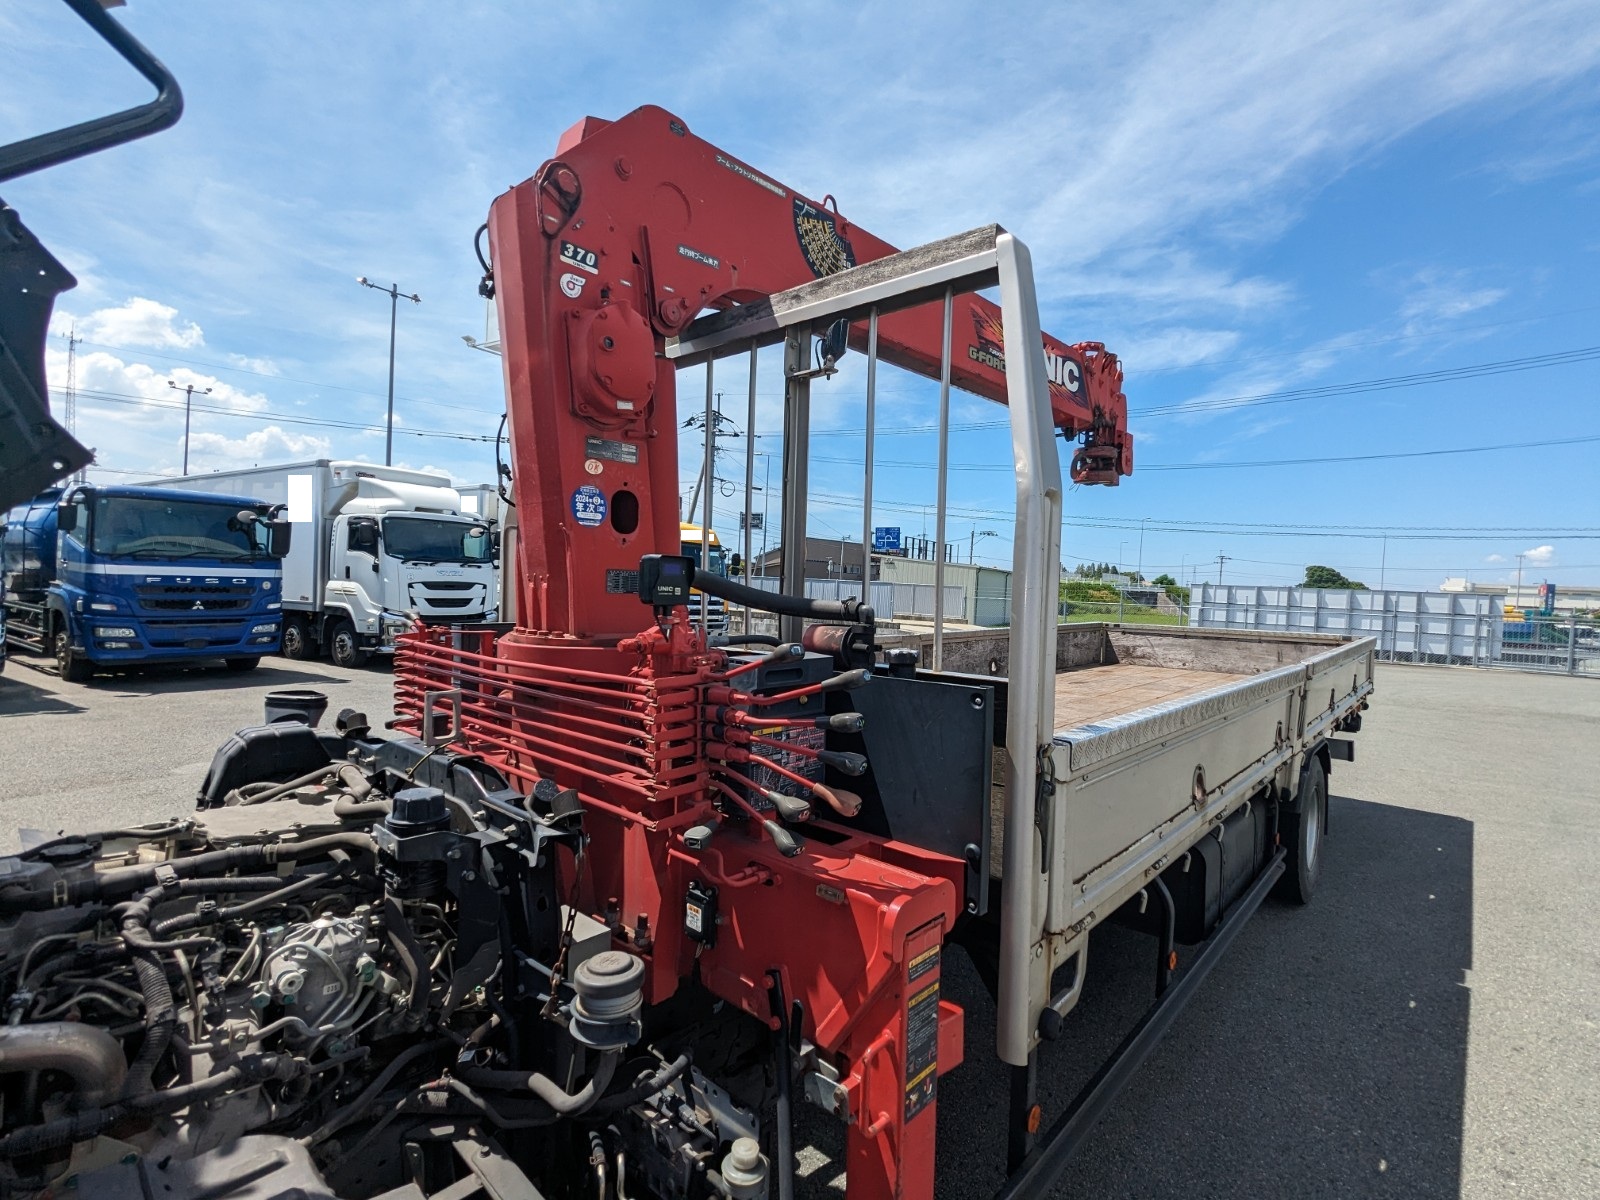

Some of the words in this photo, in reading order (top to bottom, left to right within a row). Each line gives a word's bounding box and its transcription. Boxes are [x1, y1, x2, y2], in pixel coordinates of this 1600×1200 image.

[564, 243, 596, 266] 370
[969, 346, 1006, 373] G-FORC
[1043, 349, 1080, 393] NIC
[146, 577, 247, 585] FUSO
